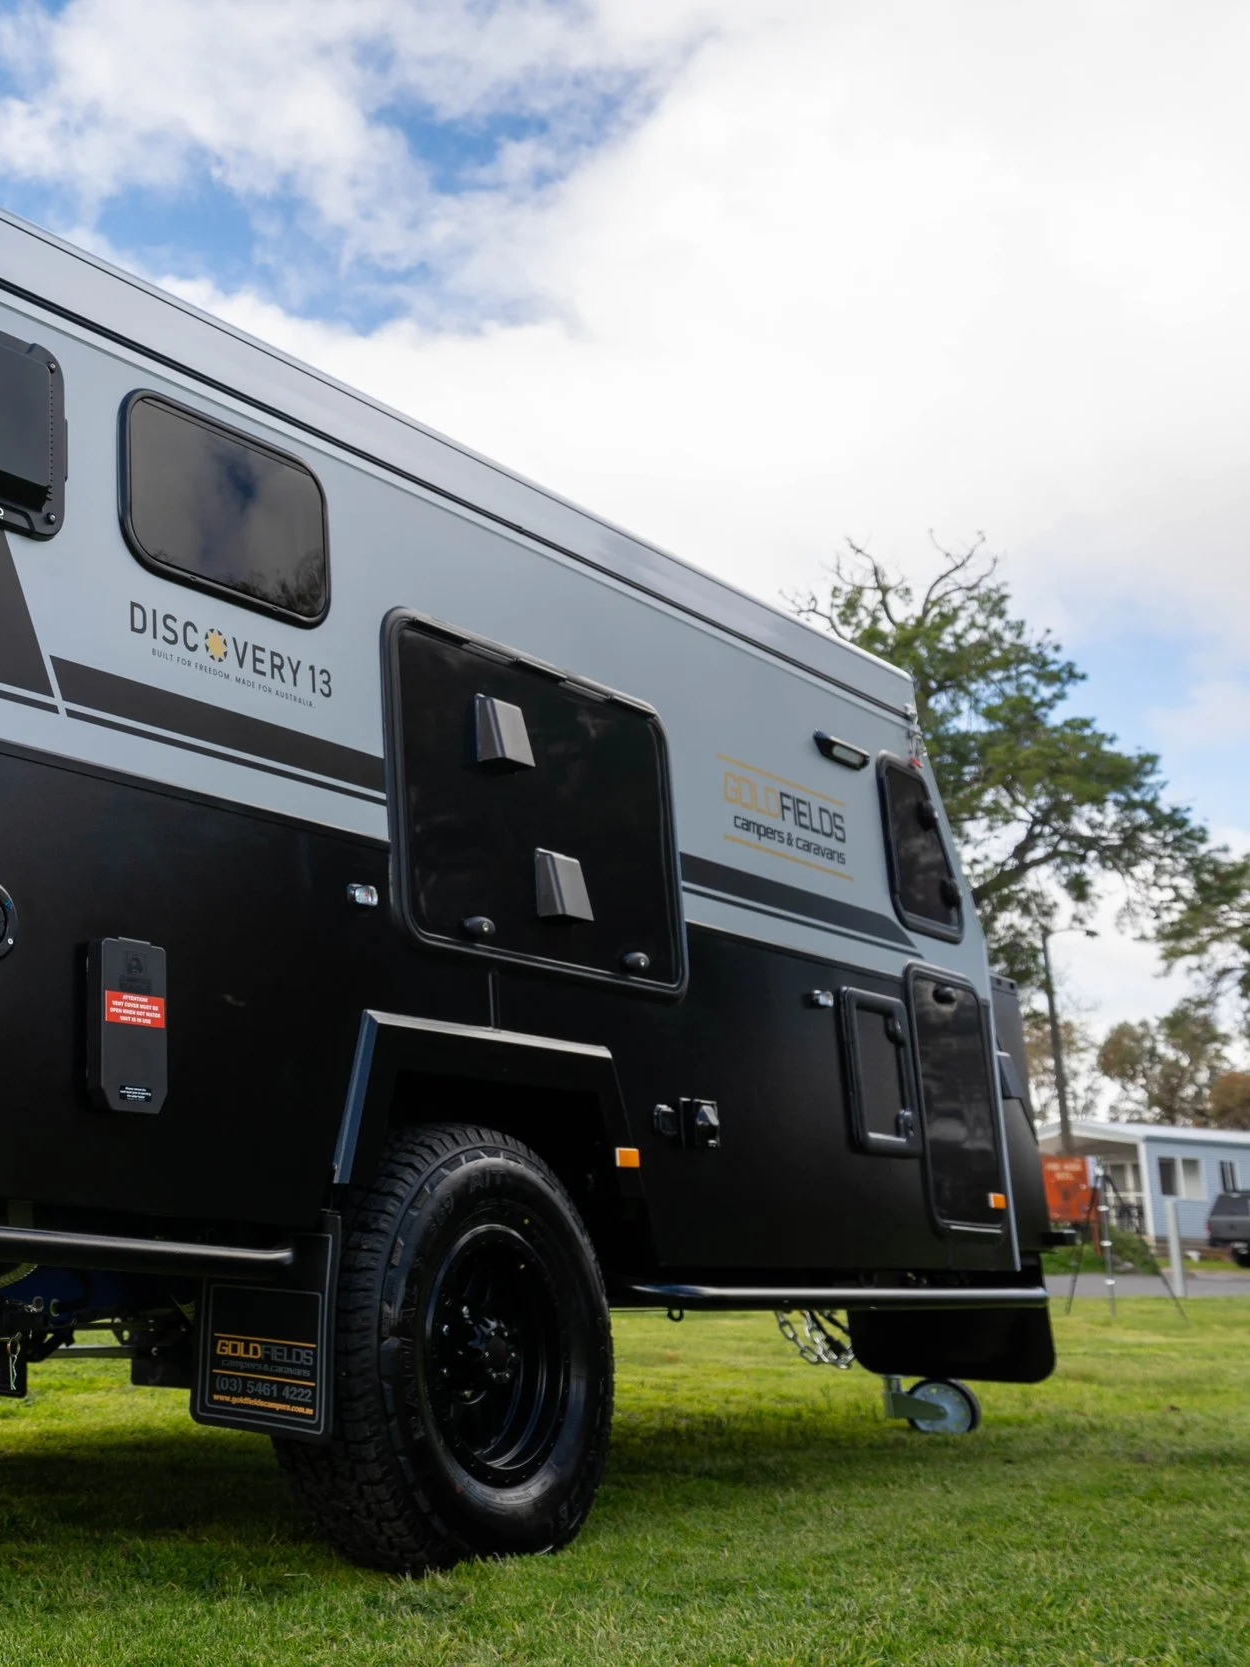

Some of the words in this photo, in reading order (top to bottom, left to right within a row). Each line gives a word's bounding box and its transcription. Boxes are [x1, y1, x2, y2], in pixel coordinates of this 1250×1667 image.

[130, 600, 302, 688] DISCOVERY
[308, 664, 332, 698] 13
[151, 648, 174, 662] BUILT
[177, 655, 192, 669] FOR
[235, 675, 256, 689] MADE
[258, 682, 272, 695] FOR
[723, 770, 847, 844] GOLDFIELDS
[733, 815, 785, 844] campers
[786, 832, 794, 847] &
[795, 837, 846, 865] caravans
[216, 1339, 314, 1366] GOLDFIELDS
[215, 1375, 243, 1394] (03)
[246, 1380, 278, 1398] 5461
[282, 1385, 313, 1403] 4222
